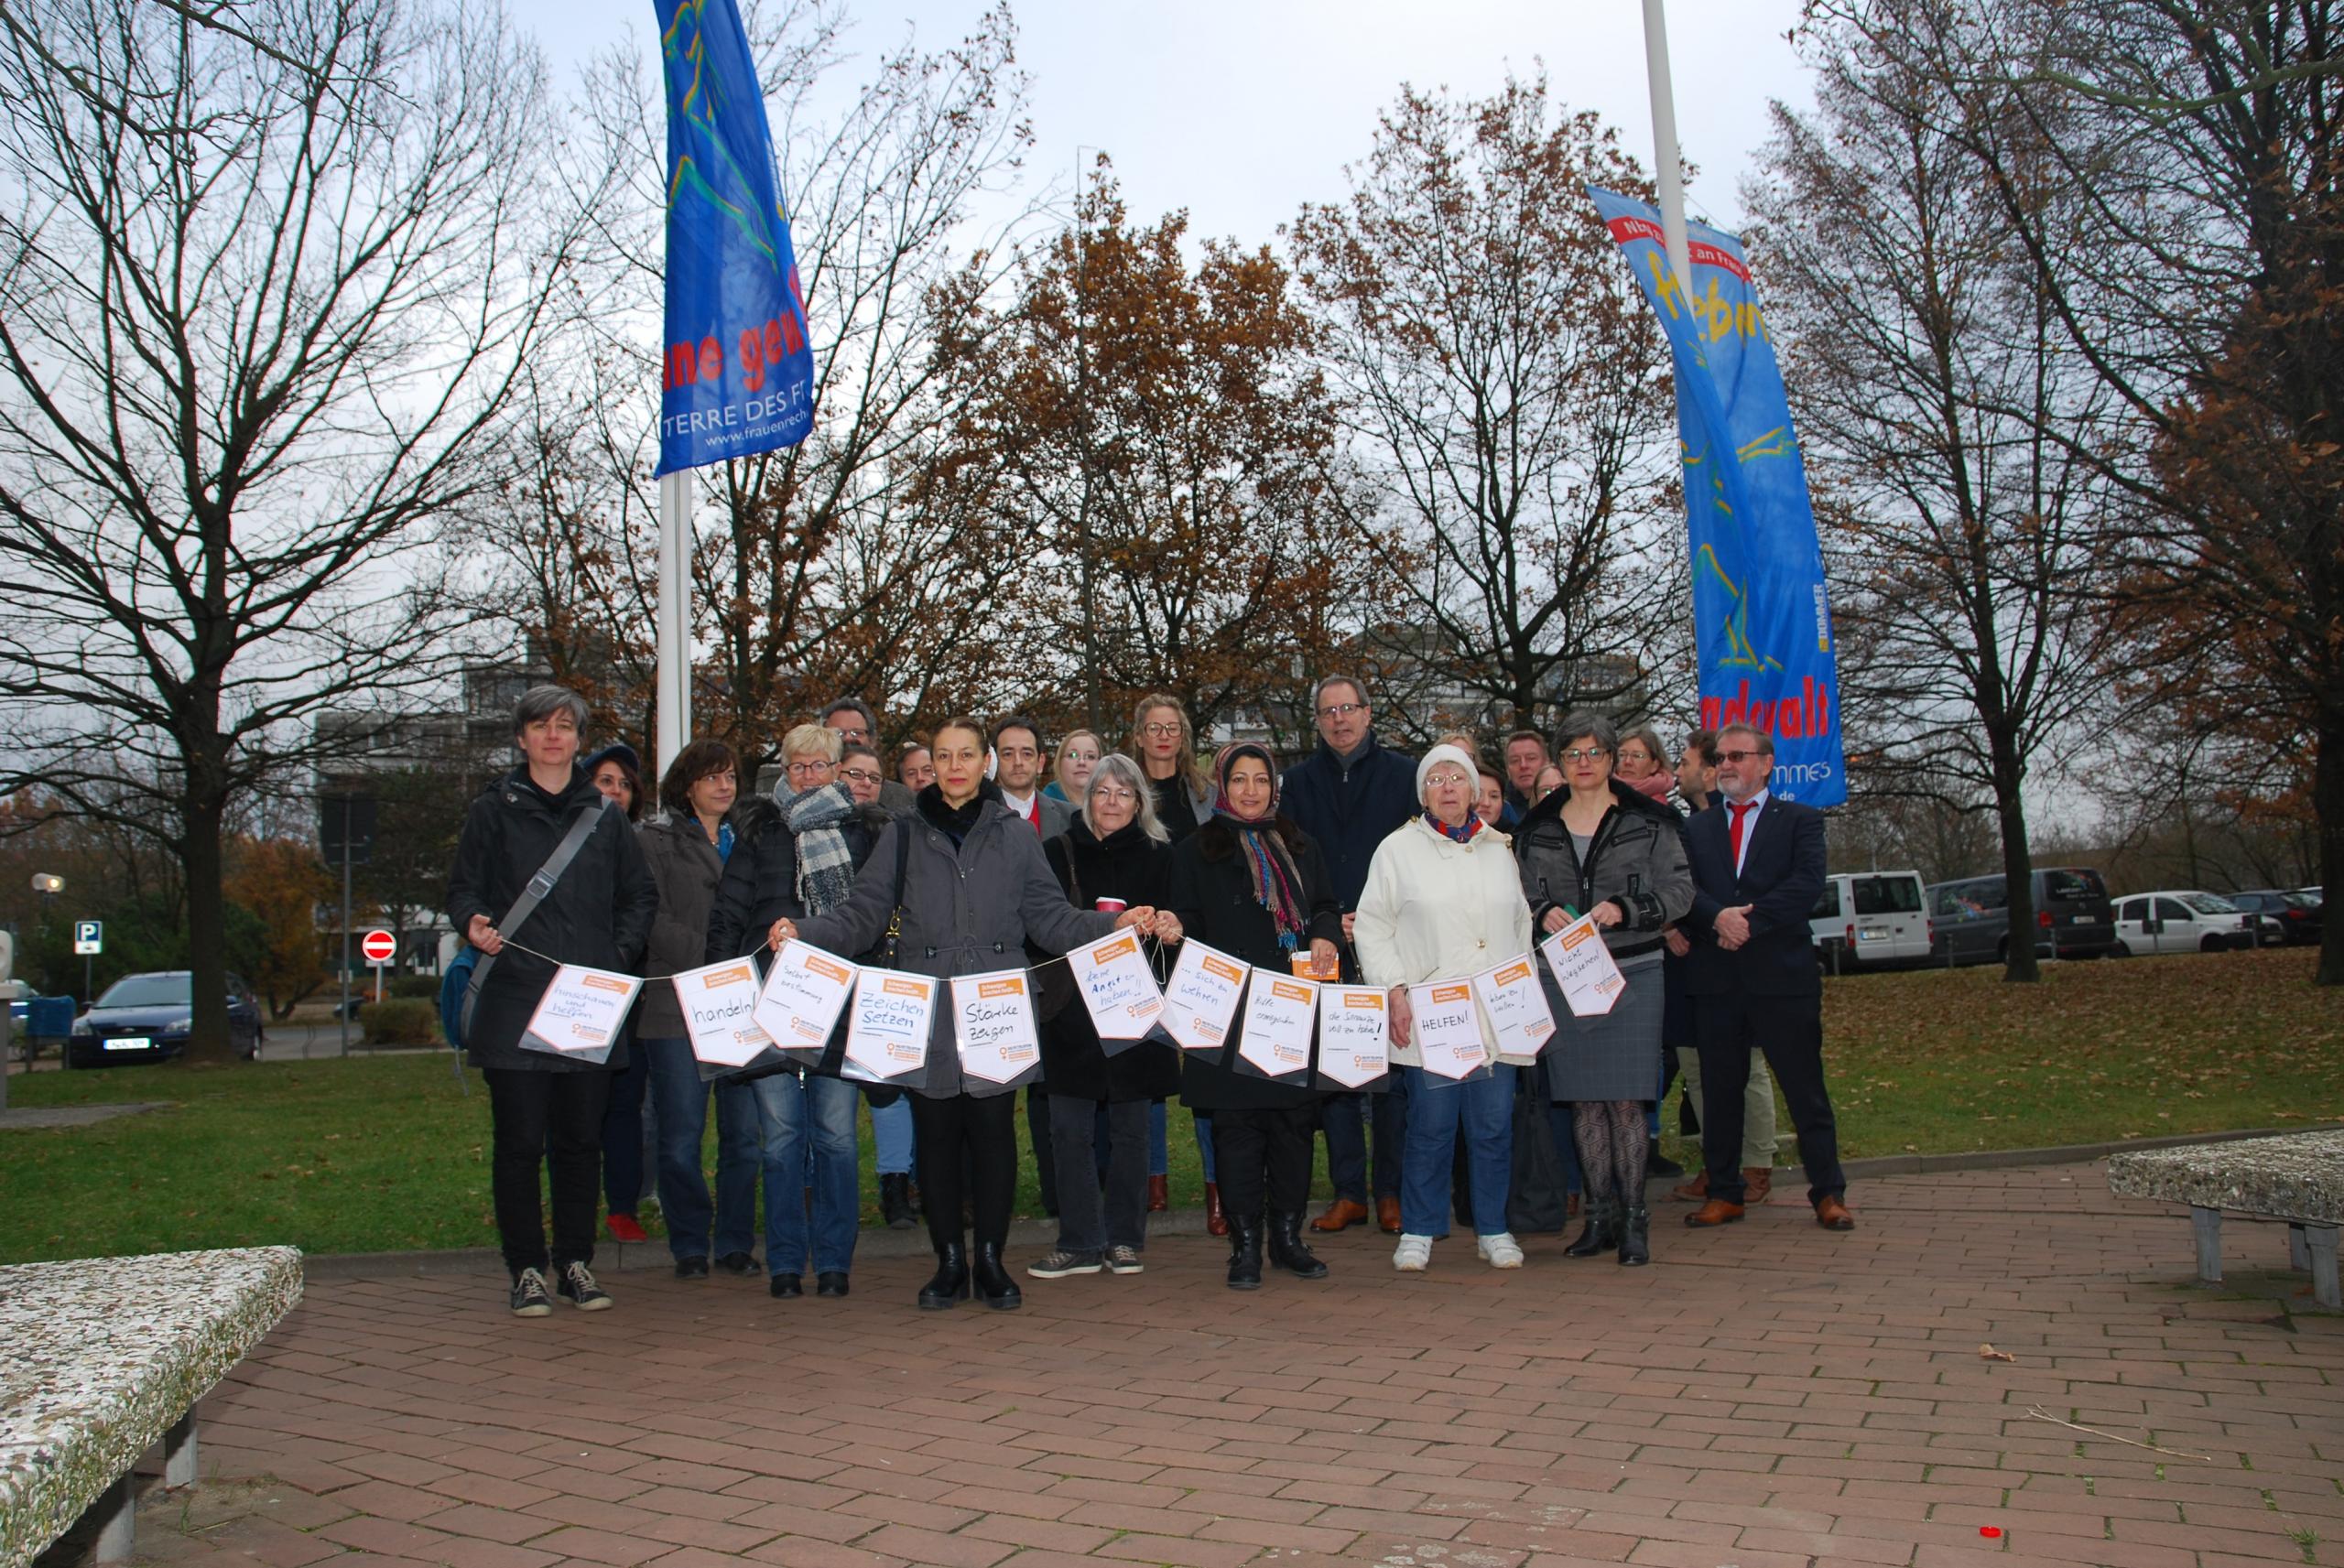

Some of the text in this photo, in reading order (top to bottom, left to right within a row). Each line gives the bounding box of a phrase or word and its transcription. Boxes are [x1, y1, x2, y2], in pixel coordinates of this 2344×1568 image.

[663, 406, 736, 438] TERRE
[745, 391, 787, 422] DES
[81, 925, 96, 941] P
[1422, 1010, 1469, 1032] HELFEN!
